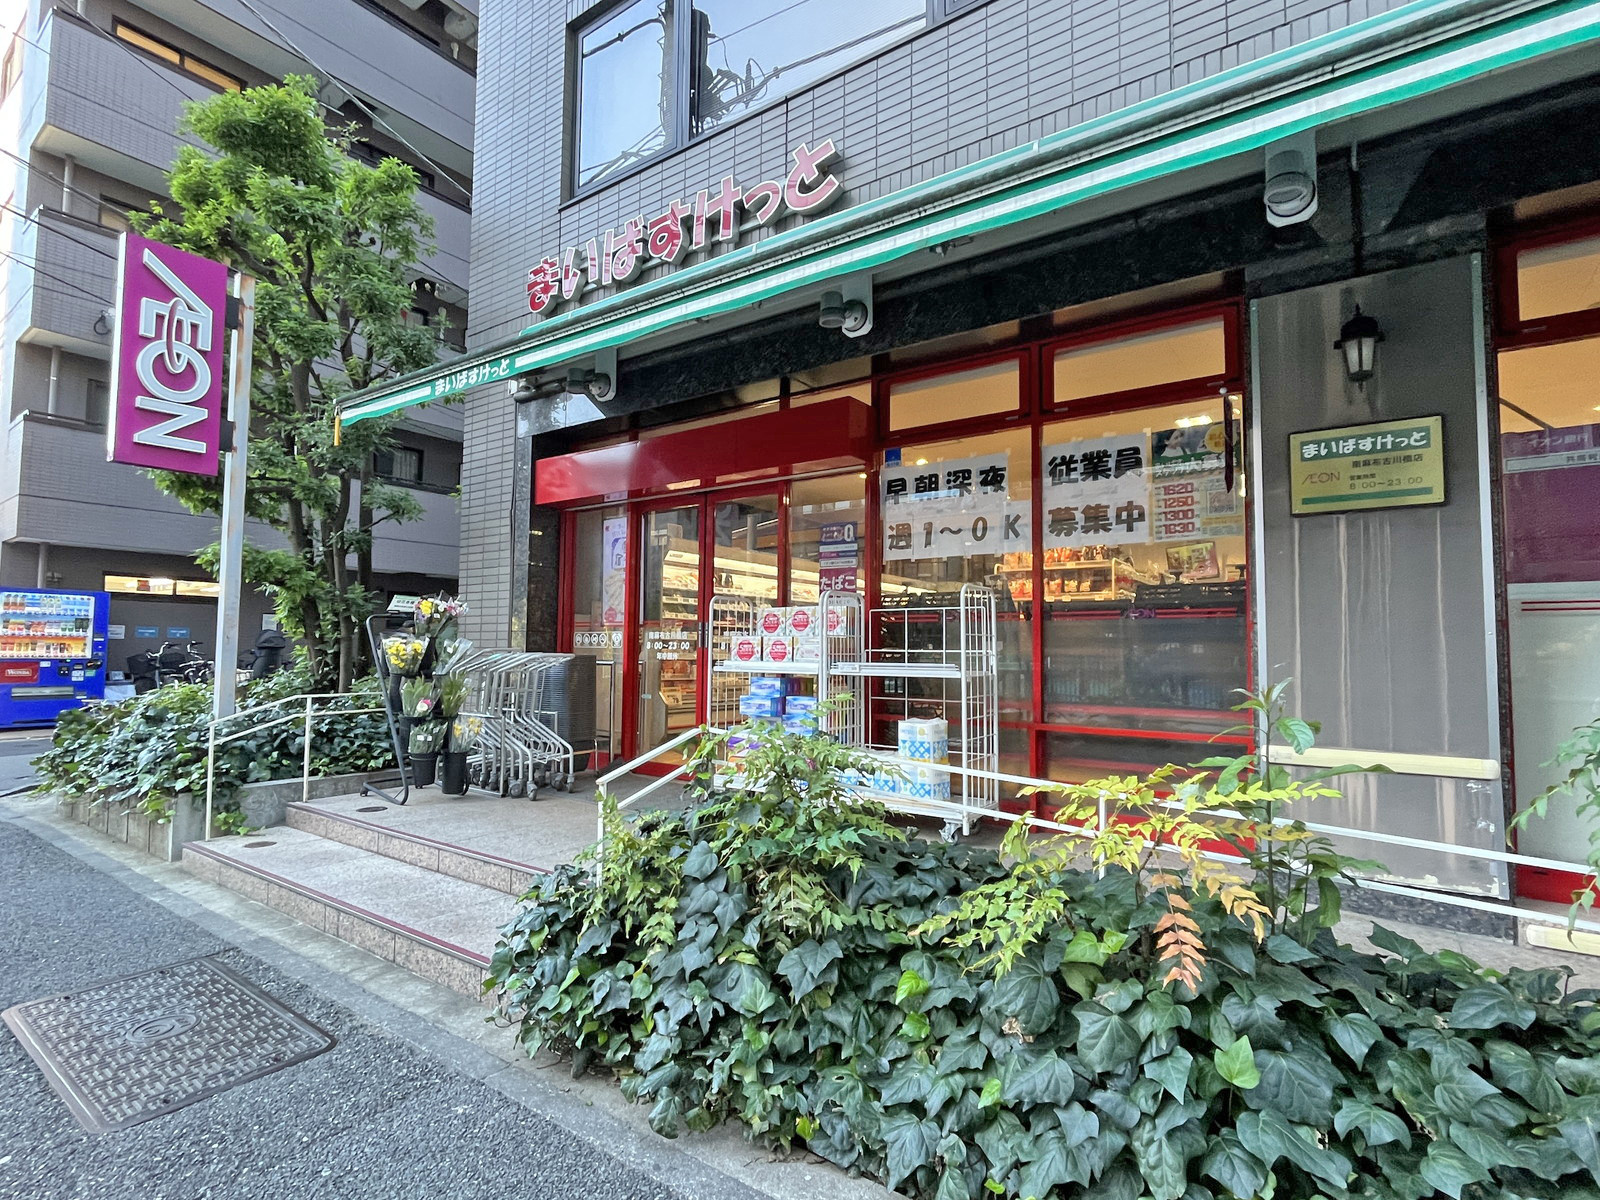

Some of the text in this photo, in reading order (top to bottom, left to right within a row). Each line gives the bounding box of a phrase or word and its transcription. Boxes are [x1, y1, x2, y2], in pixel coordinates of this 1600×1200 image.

[527, 138, 842, 314] まいばすけっと
[133, 248, 214, 454] AEON
[434, 358, 510, 395] まいばすけっと
[1302, 431, 1428, 459] まいばすけっと
[886, 465, 1007, 505] 早朝深夜
[1048, 446, 1145, 487] 従業員
[1302, 471, 1340, 486] AEON
[1048, 500, 1146, 538] 募集中
[1163, 508, 1195, 522] 1300
[820, 575, 856, 591] たばこ
